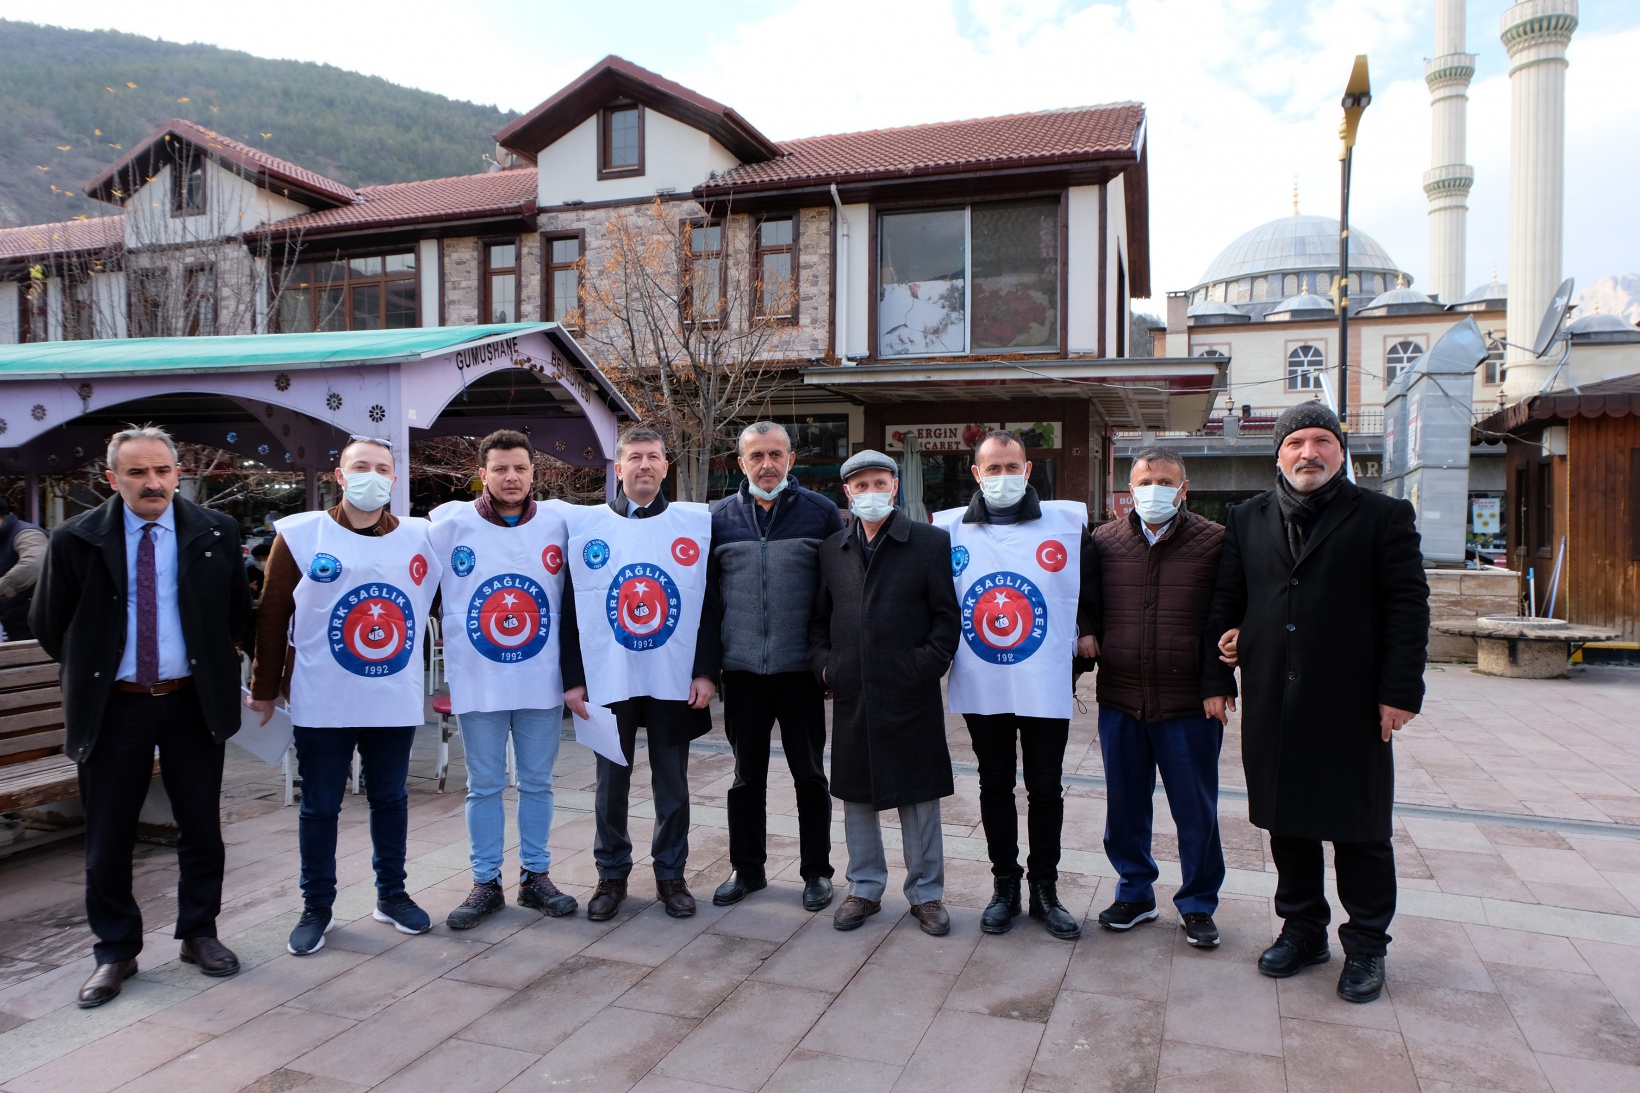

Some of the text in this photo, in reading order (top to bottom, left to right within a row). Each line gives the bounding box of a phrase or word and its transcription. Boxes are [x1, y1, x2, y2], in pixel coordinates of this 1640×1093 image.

[920, 441, 961, 450] İCARET
[1119, 496, 1133, 505] BÜ
[468, 597, 484, 640] TÜRK
[482, 575, 539, 596] SAĞLIK
[962, 596, 976, 641] TÜRK
[974, 574, 1032, 595] SAĞLIK
[330, 606, 349, 652] TÜRK
[348, 585, 406, 607] SAĞLIK
[633, 639, 653, 649] 1992
[500, 651, 523, 661] 1992
[364, 665, 389, 675] 1992
